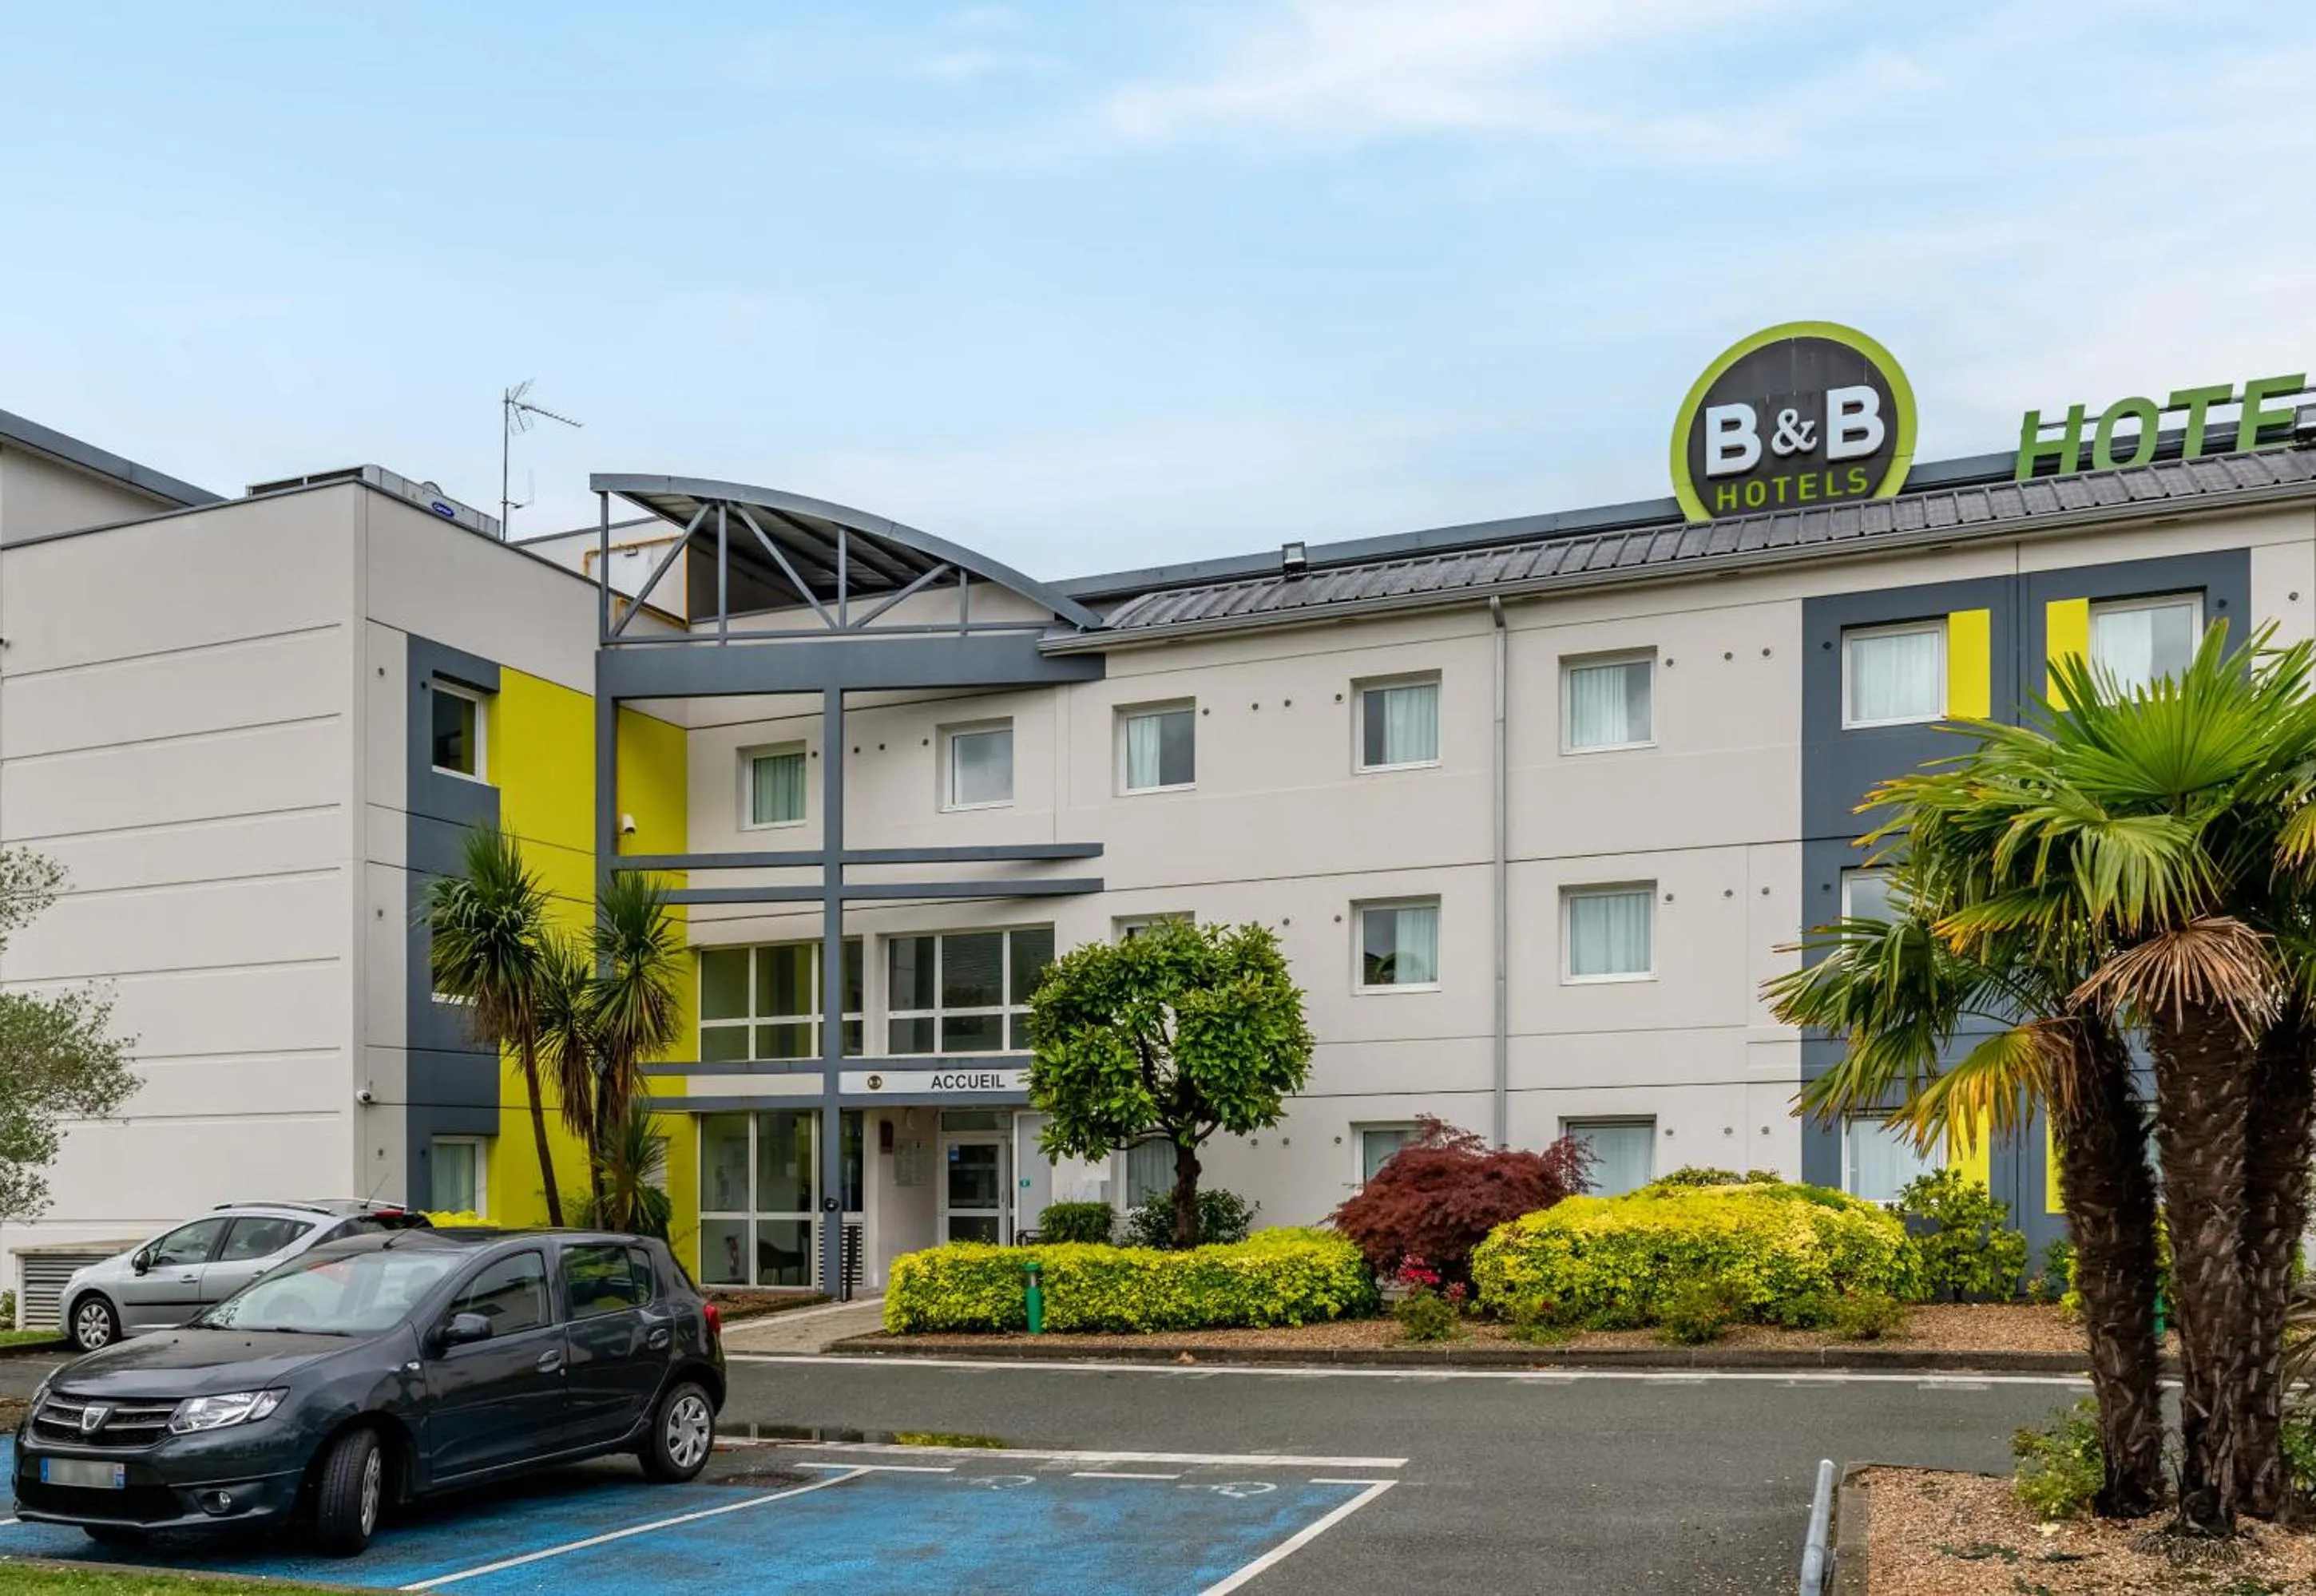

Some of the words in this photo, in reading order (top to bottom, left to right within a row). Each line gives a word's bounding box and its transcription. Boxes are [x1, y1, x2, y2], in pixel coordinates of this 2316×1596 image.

[1706, 385, 1886, 477] B&B
[1716, 467, 1869, 512] HOTELS
[930, 1074, 1005, 1089] ACCUEIL
